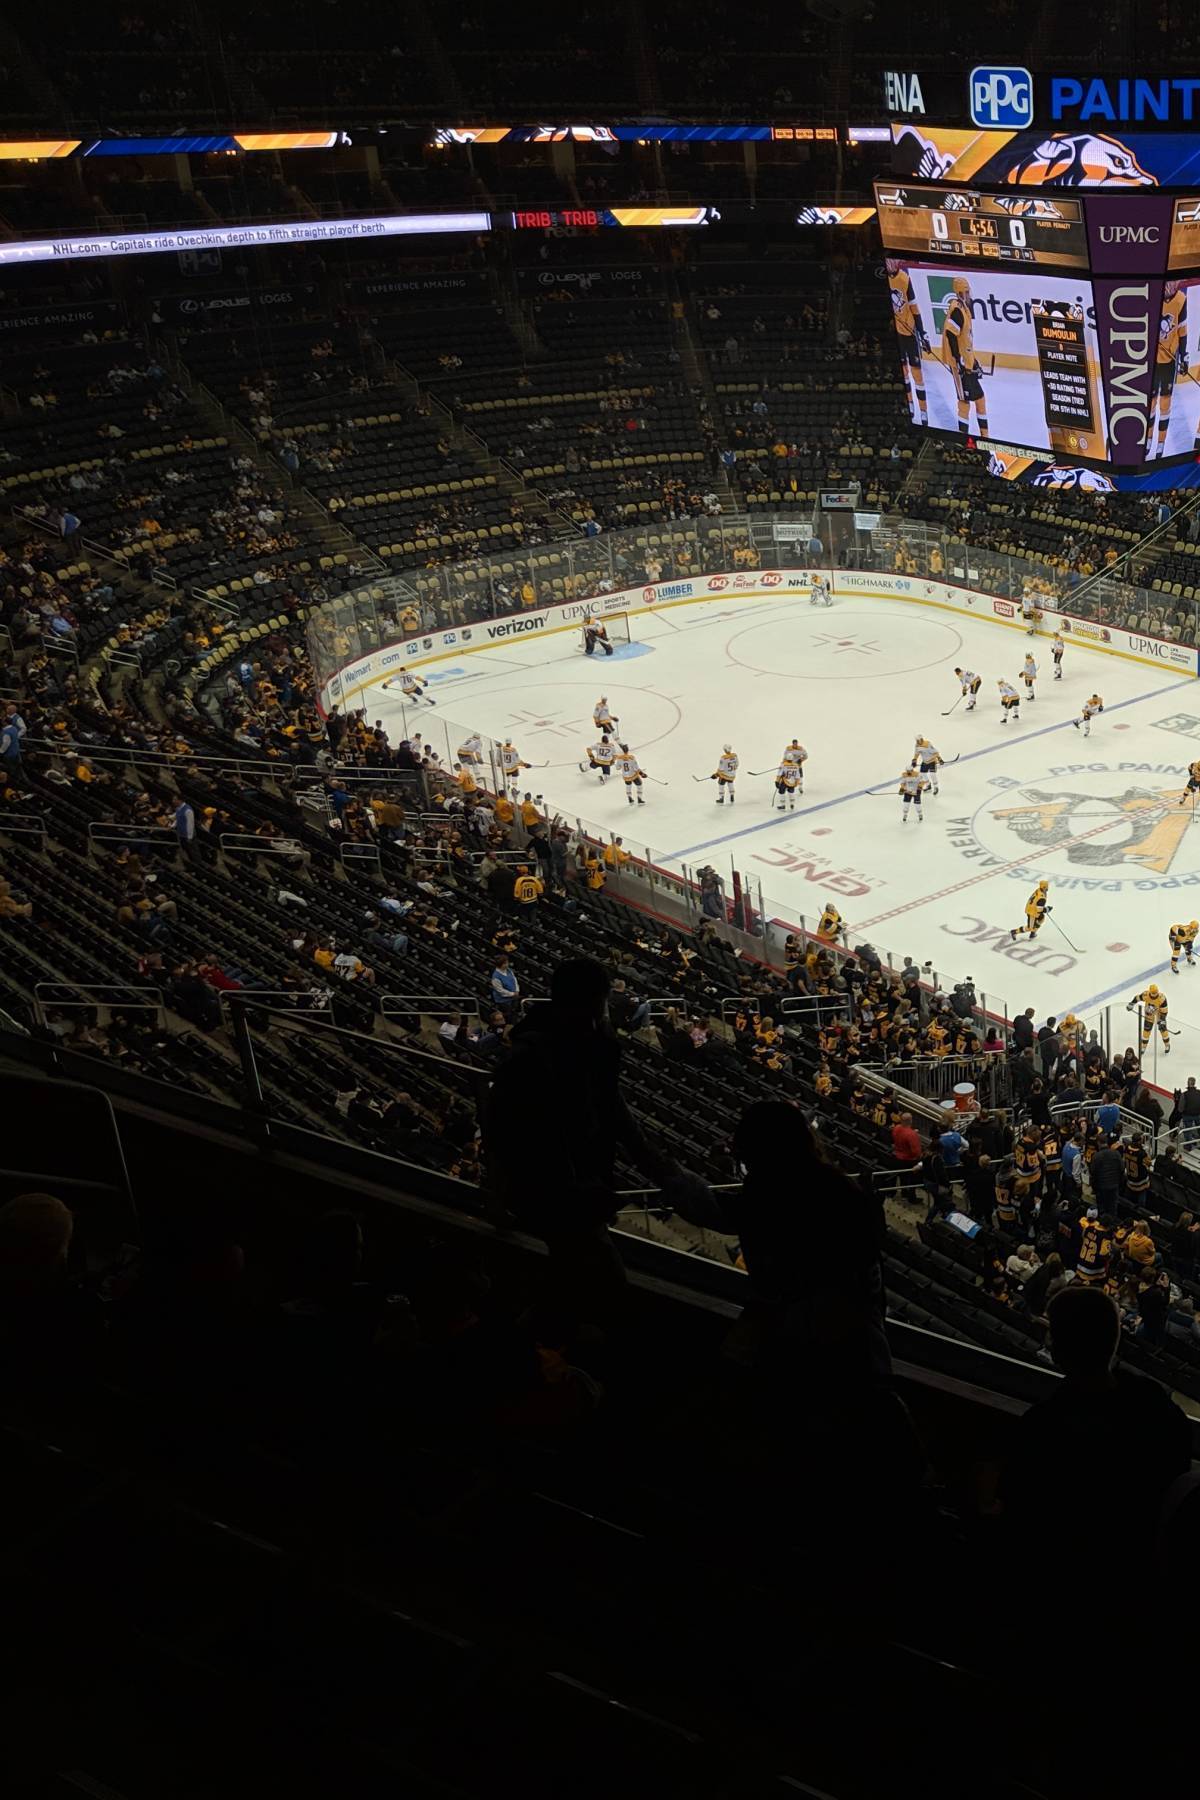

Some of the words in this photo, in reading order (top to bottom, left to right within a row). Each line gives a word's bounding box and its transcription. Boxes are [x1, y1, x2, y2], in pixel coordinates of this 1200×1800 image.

[886, 72, 926, 114] ENA
[974, 74, 1029, 121] PPG
[516, 212, 551, 228] TRIB
[561, 211, 597, 225] TRIB
[932, 213, 948, 239] 0
[969, 221, 994, 237] 4:54
[1009, 220, 1026, 247] 0
[52, 243, 101, 255] NHL.com
[110, 240, 152, 252] Capitals
[154, 238, 174, 248] ride
[177, 234, 225, 246] Ovechkin,
[227, 231, 255, 244] depth
[257, 231, 267, 241] to
[269, 227, 289, 239] fifth
[291, 226, 327, 240] straight
[329, 224, 359, 238] playoff
[361, 222, 385, 233] berth
[1099, 226, 1160, 243] UPMC
[611, 271, 642, 280] LOGES
[423, 279, 467, 289] AMAZING
[260, 294, 293, 304] LOGES
[44, 312, 94, 324] AMAZING
[1042, 328, 1077, 341] DUMOULIN
[1047, 352, 1065, 361] PLAYER
[1065, 354, 1078, 362] NOTE
[1108, 283, 1149, 446] UPMC
[1044, 371, 1059, 380] LEADS
[1059, 373, 1073, 382] TEAM
[1073, 376, 1086, 384] WITH
[1057, 385, 1075, 394] RATING
[1050, 404, 1060, 412] FOR
[1018, 449, 1057, 464] ELECTRIC
[710, 578, 727, 588] DQ
[763, 574, 779, 584] DQ
[847, 576, 894, 589] HIGHMARK
[658, 584, 693, 598] LUMBER
[604, 596, 626, 605] SPORTS
[561, 601, 600, 621] UPMC
[487, 615, 544, 638] verizon
[1128, 636, 1169, 659] UPMC
[344, 662, 372, 683] Walmart
[381, 652, 400, 665] com
[402, 675, 413, 684] 76
[1048, 762, 1110, 777] PPG
[946, 815, 1003, 868] ARENA
[751, 847, 872, 898] GNC
[839, 866, 887, 888] LIVE
[939, 915, 1079, 977] UPMC
